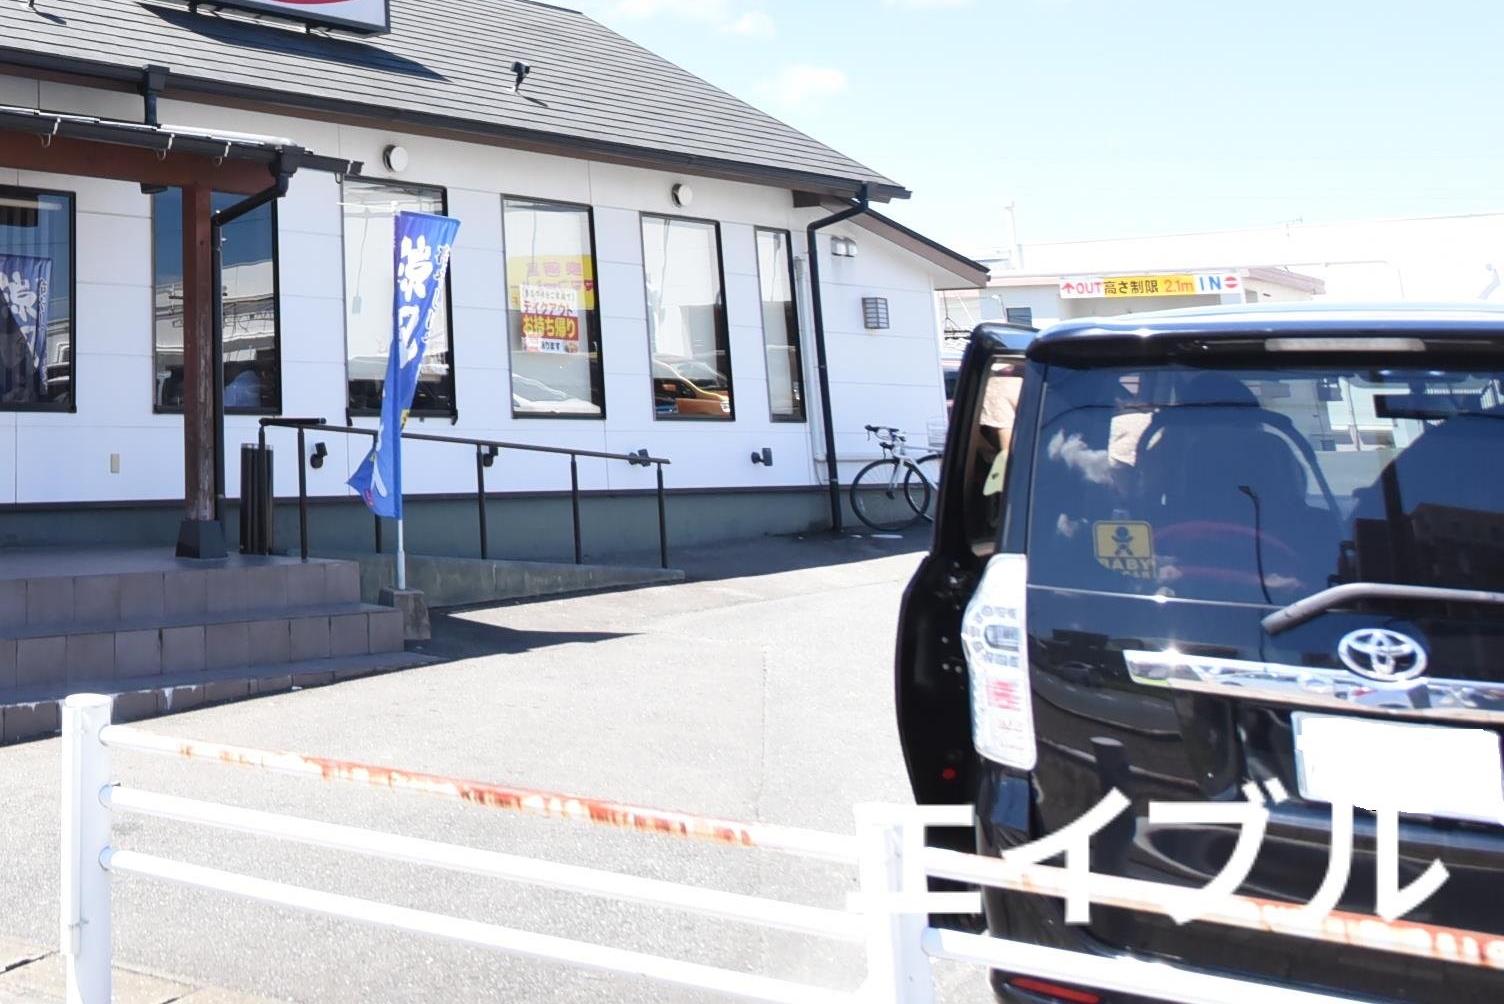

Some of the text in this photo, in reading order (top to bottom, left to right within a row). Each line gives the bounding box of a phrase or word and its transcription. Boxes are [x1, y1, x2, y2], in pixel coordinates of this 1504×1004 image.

[1076, 276, 1221, 295] OUT 高さ制限 2.1m IN
[522, 314, 576, 339] お持ち帰り
